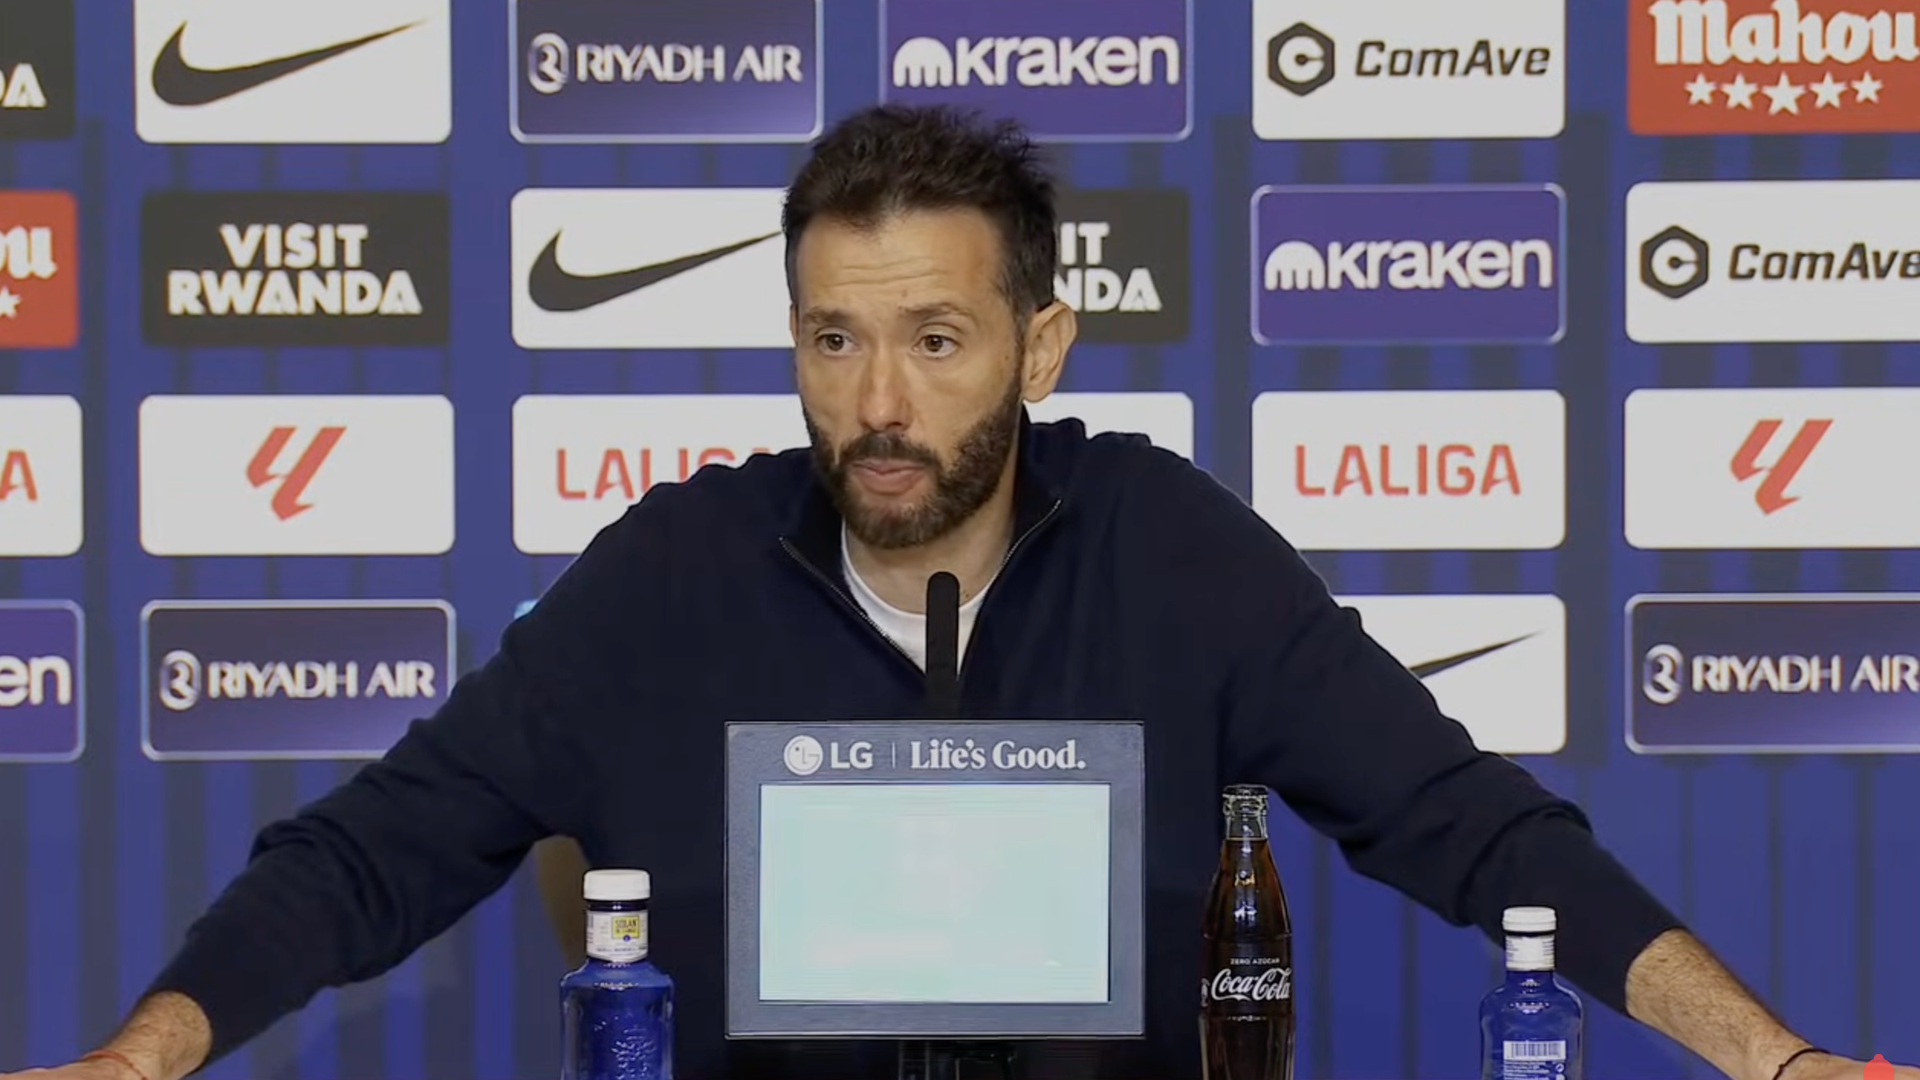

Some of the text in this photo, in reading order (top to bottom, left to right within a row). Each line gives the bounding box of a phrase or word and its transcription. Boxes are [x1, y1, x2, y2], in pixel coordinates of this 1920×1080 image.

[1648, 0, 1920, 65] Mahou
[576, 44, 803, 82] RIYADH AIR
[1355, 39, 1551, 77] ComAve
[220, 223, 368, 267] VISIT
[167, 270, 423, 315] RWANDA
[1295, 444, 1521, 496] LALIGA
[207, 661, 435, 698] RIYADH AIR
[1692, 654, 1920, 693] RIYADH AIR
[830, 738, 1087, 769] LG Life's Good.
[1230, 958, 1251, 966] ZERO
